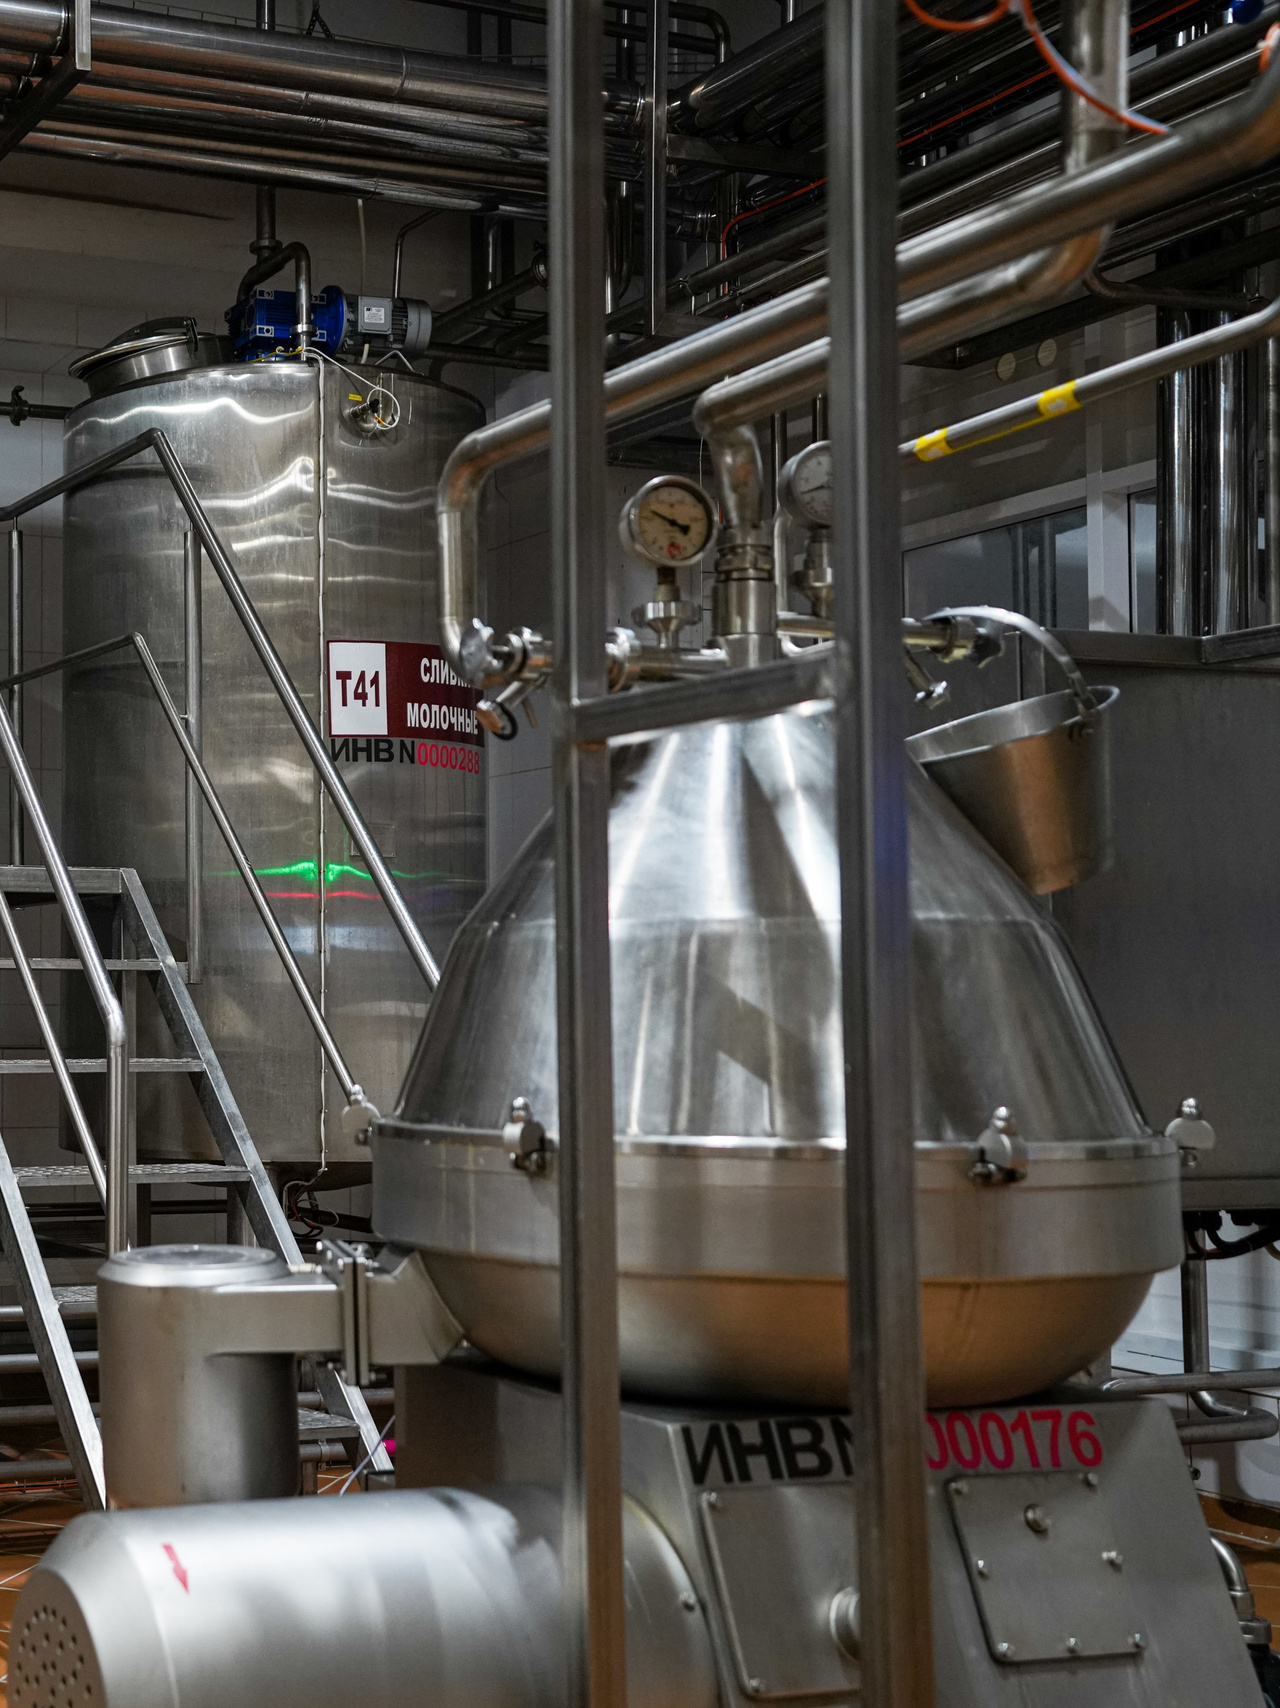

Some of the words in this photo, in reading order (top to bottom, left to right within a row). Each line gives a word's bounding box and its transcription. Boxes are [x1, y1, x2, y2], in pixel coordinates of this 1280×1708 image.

[336, 670, 381, 707] Т41
[420, 657, 471, 688] СЛИВ
[406, 702, 479, 735] МОЛОЧНЫЕ
[924, 1409, 1103, 1470] 000176
